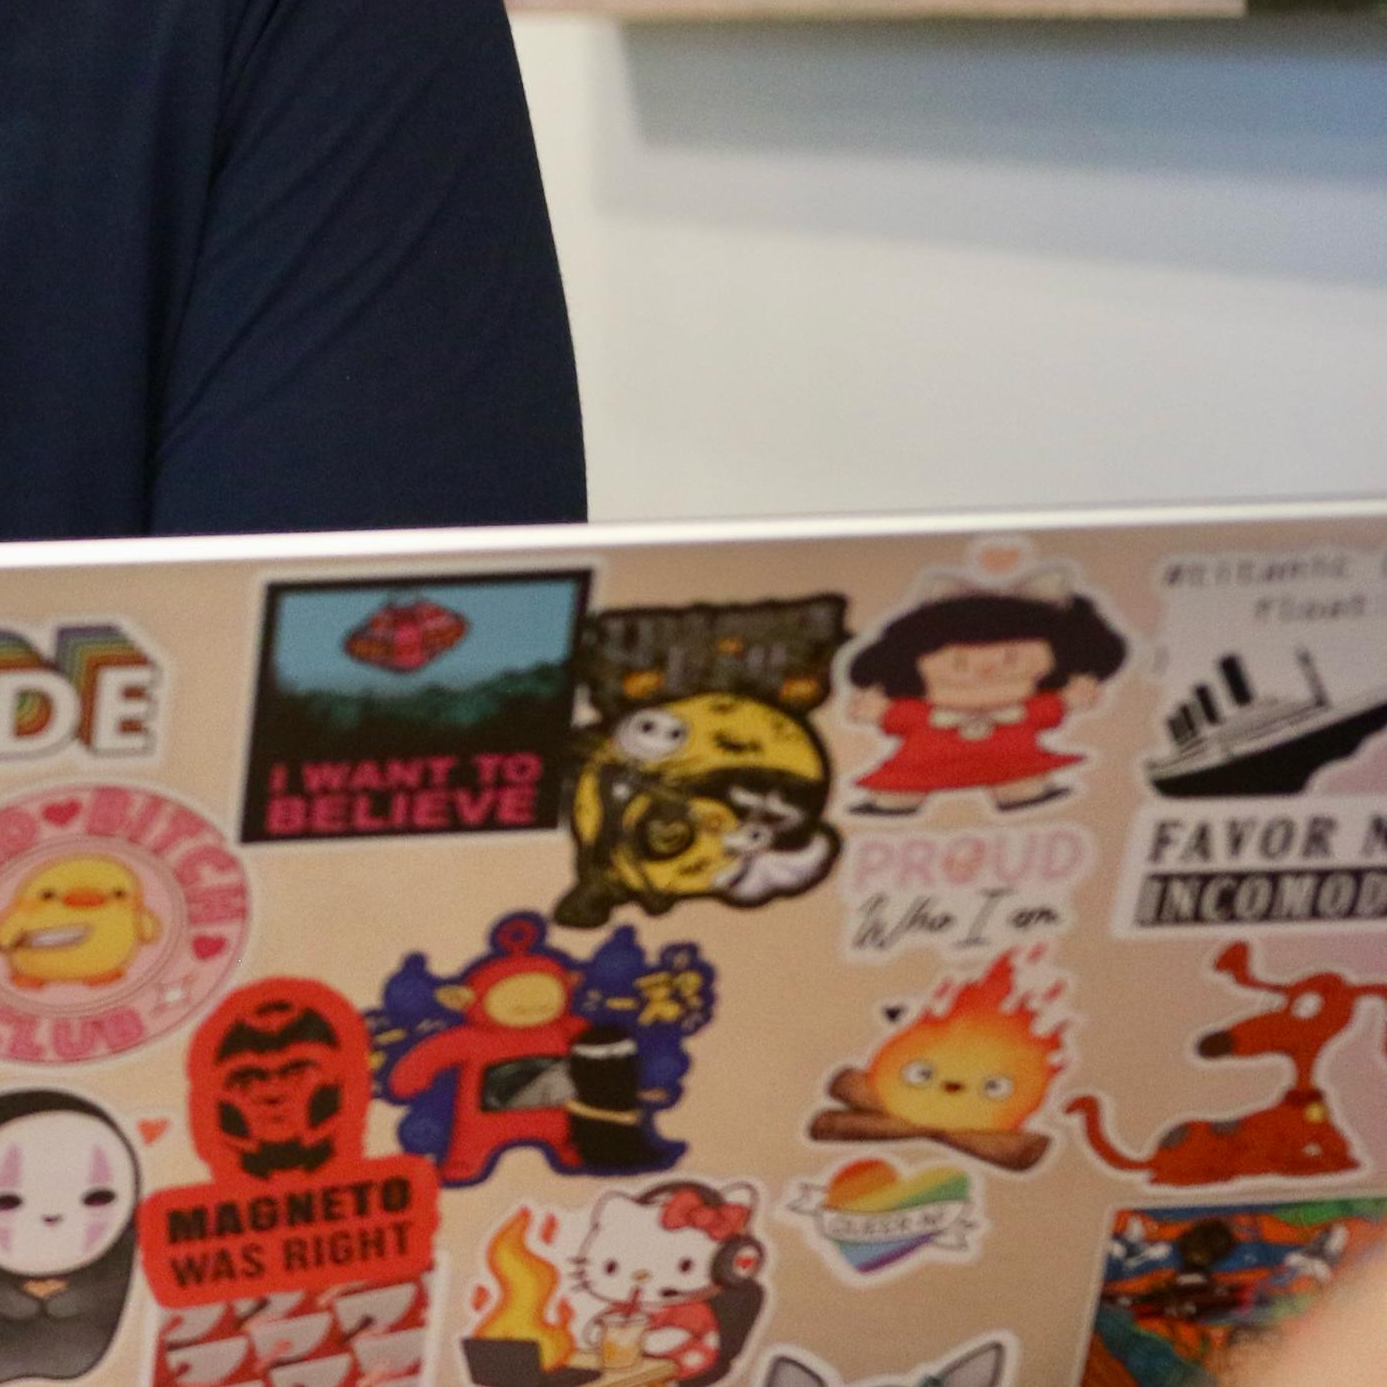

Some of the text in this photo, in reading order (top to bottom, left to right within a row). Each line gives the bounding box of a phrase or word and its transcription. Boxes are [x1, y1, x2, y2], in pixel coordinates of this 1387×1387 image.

[268, 751, 543, 794] I WANT TO
[266, 785, 539, 835] BELIEVE
[852, 829, 1084, 891] PROUD
[1148, 816, 1338, 863] FAVOR
[166, 1175, 411, 1245] MAGNETO
[170, 1221, 412, 1288] WAS RIGHT
